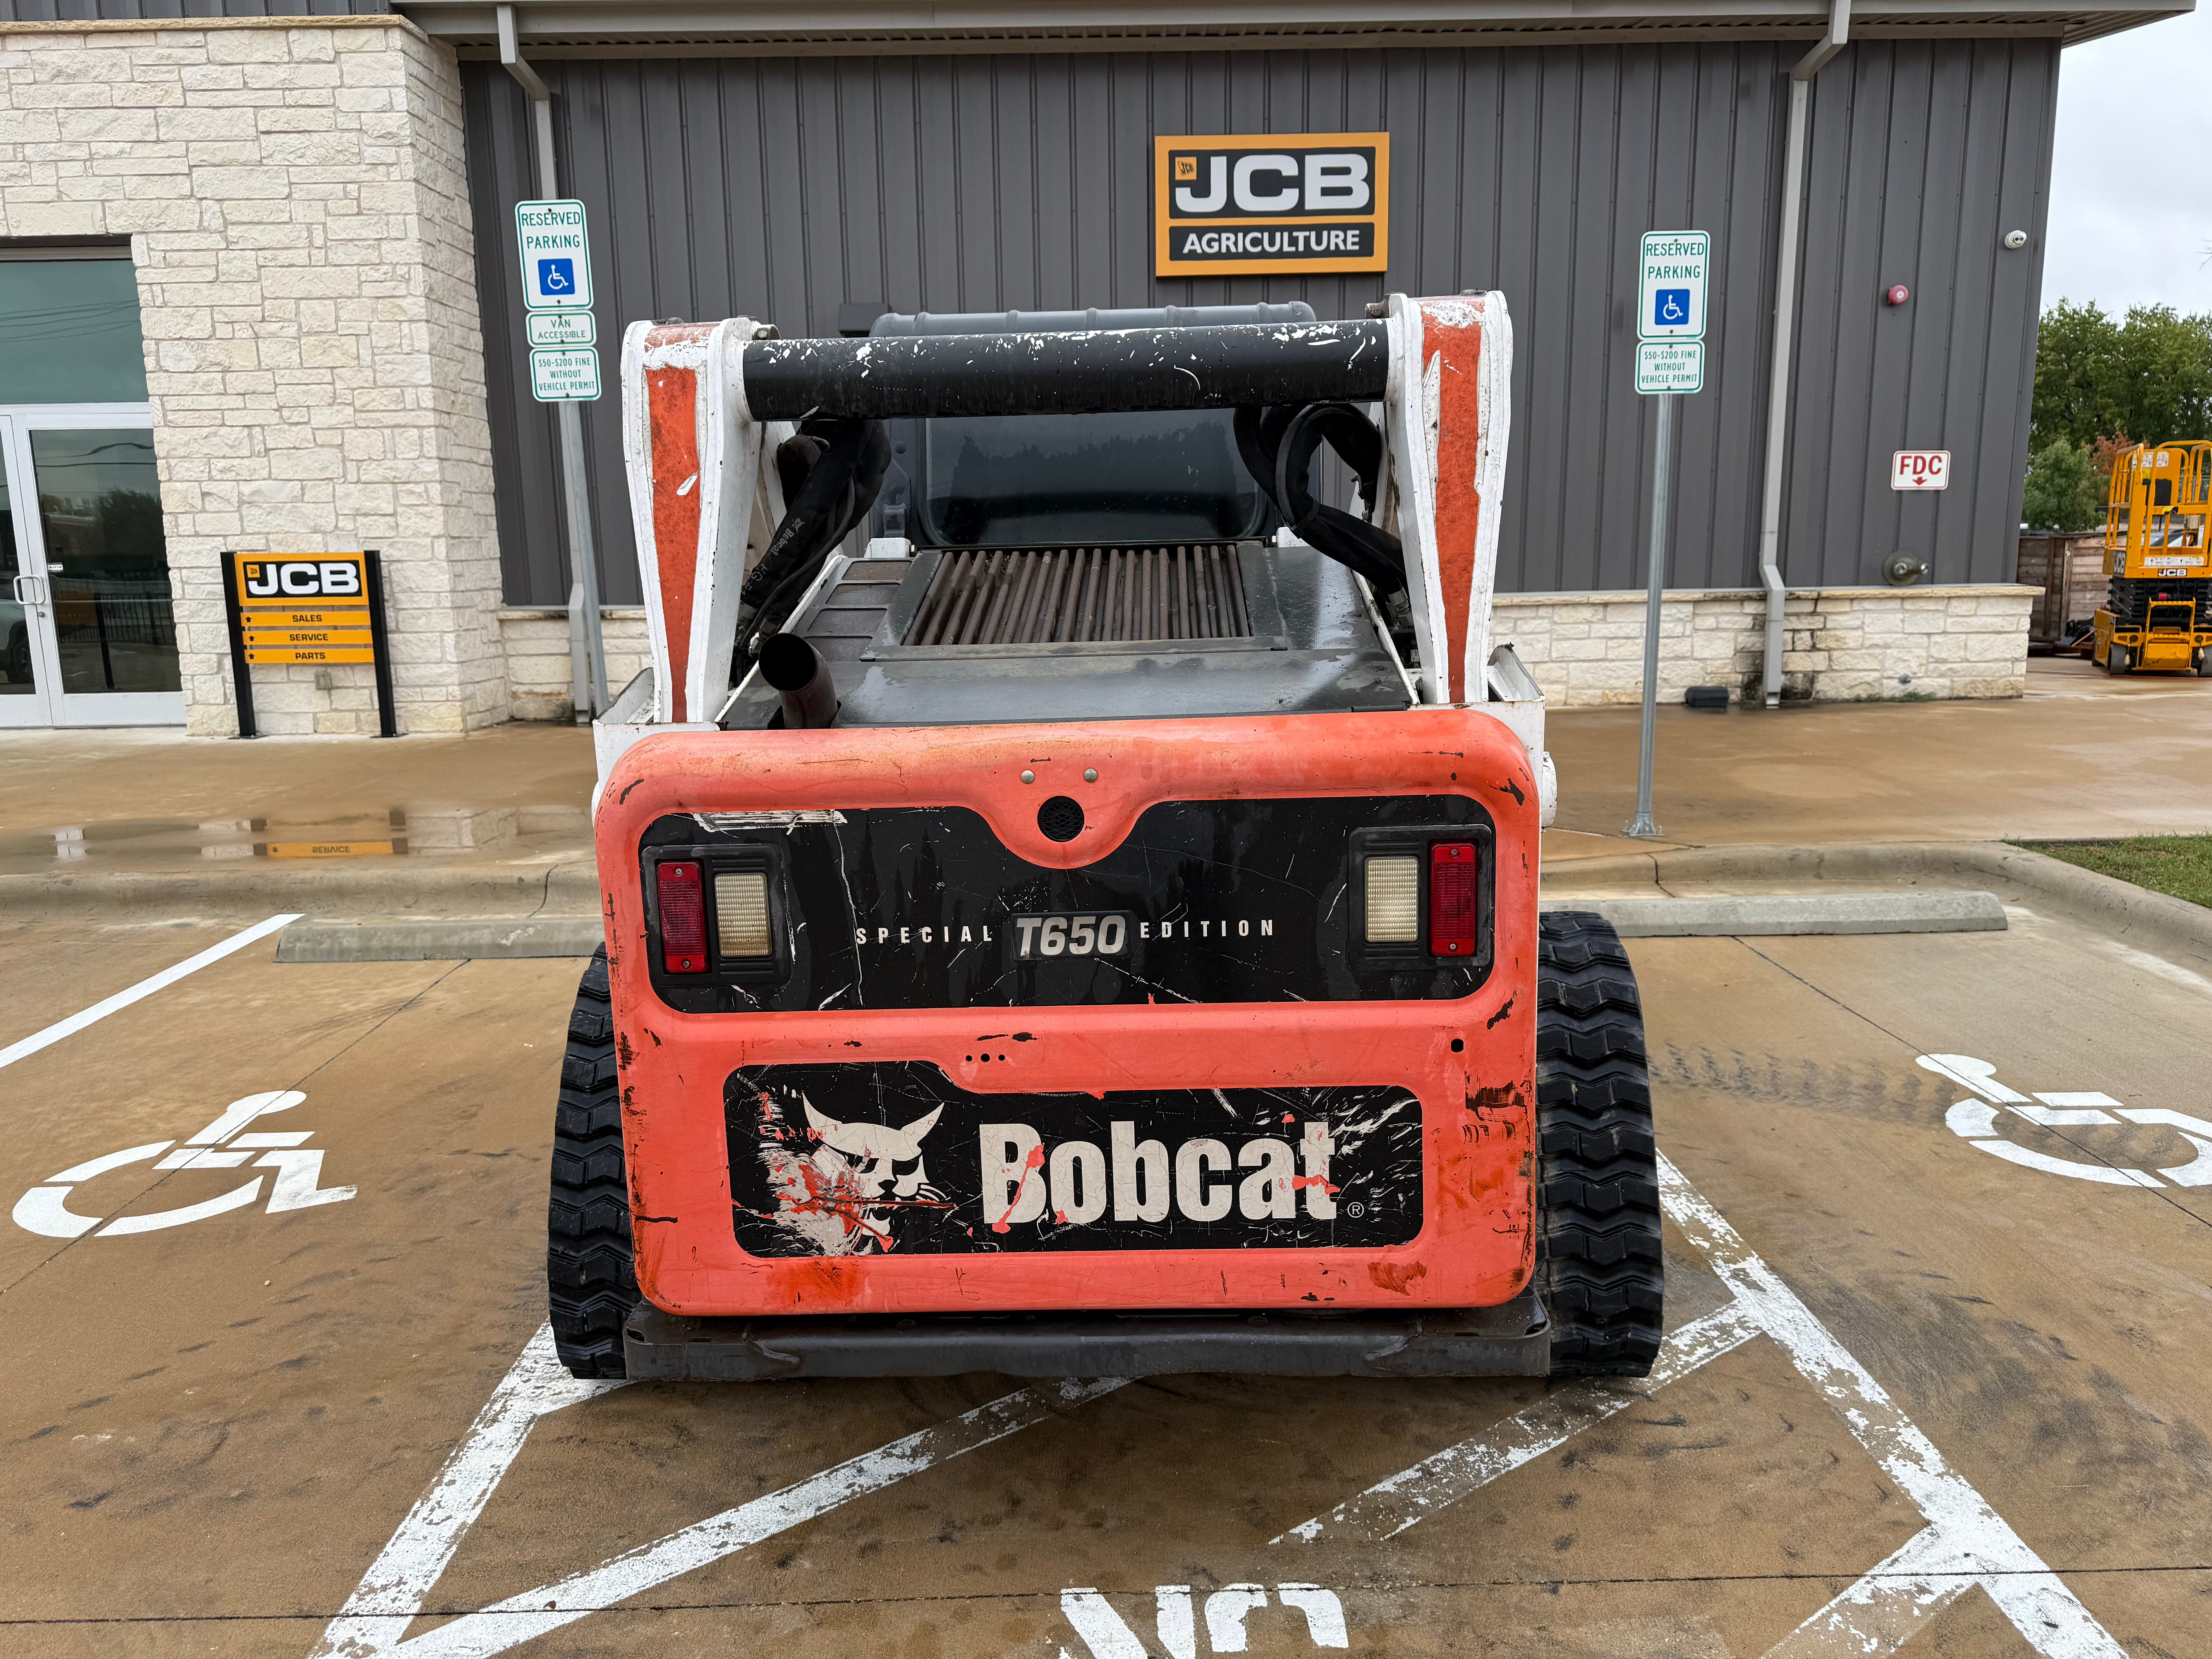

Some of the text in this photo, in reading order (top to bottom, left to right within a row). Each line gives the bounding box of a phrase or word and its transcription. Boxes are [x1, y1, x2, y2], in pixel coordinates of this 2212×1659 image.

[1176, 154, 1369, 212] JCB
[522, 211, 580, 226] RESERVED
[527, 234, 580, 249] PARKING
[1183, 230, 1360, 253] AGRICULTURE
[1646, 242, 1704, 256] RESERVED
[1648, 265, 1700, 279] PARKING
[551, 319, 571, 328] VAN
[538, 330, 586, 339] ACCESSIBLE
[1645, 350, 1697, 360] $50-$200 FINE
[539, 357, 591, 368] $50-$200 FINE
[1654, 362, 1685, 371] WITHOUT
[550, 369, 581, 379] WITHOUT
[1642, 374, 1697, 383] VEHICLE PERMIT
[538, 381, 594, 391] VEHICLE PERMIT
[1900, 455, 1942, 475] FDC
[770, 528, 795, 556] Bobcat
[248, 563, 359, 595] JCB
[856, 917, 1273, 956] SPECIAL T650 EDITION
[979, 1121, 1338, 1224] Bobcat
